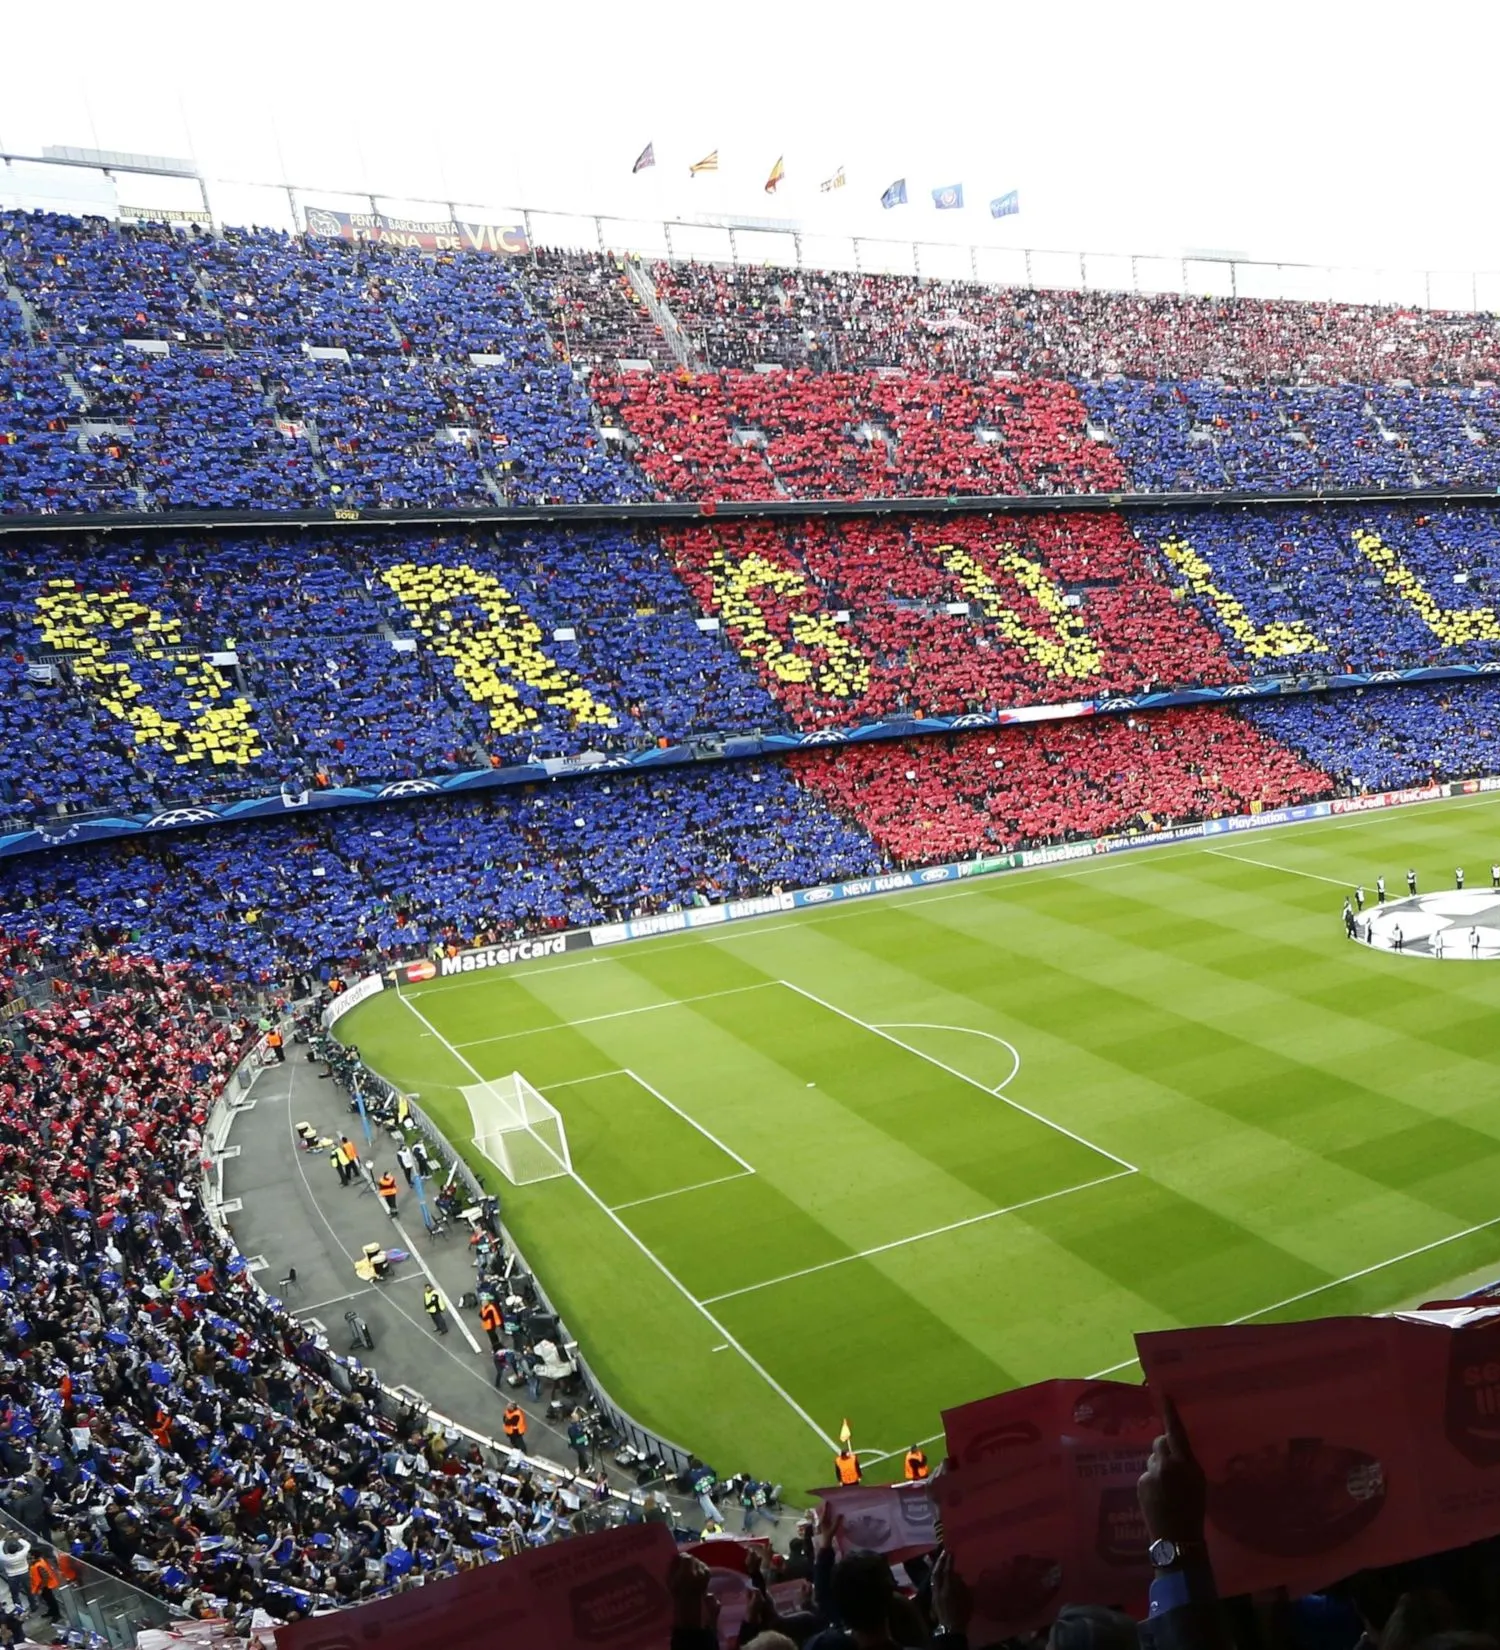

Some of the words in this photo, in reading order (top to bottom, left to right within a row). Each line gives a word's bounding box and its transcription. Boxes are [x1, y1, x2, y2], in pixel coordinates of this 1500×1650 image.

[350, 214, 383, 229] PENYA
[388, 218, 458, 235] BARCELONISTA
[435, 236, 461, 250] DE
[463, 223, 520, 251] VIC
[1228, 810, 1288, 831] PlayStation
[1022, 846, 1094, 867] Heineken
[842, 883, 872, 897] NEW
[875, 875, 914, 891] KUGA
[441, 936, 567, 976] MasterCard
